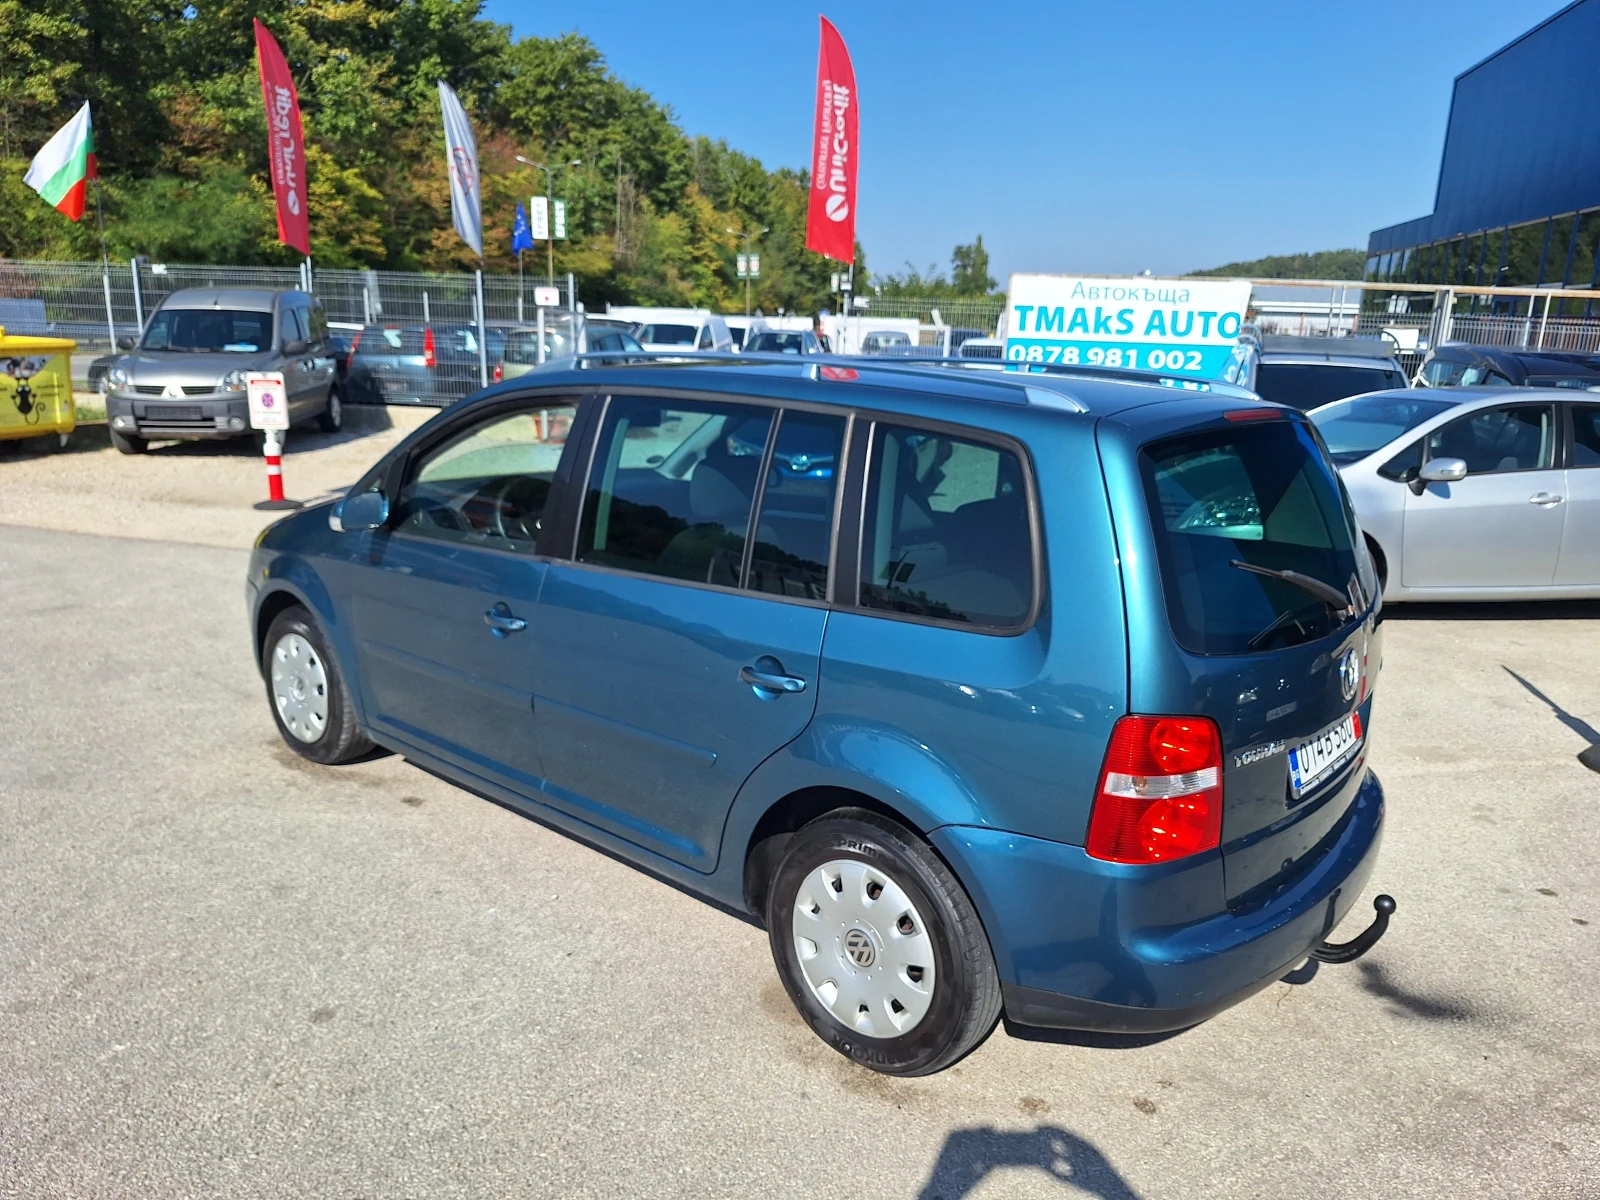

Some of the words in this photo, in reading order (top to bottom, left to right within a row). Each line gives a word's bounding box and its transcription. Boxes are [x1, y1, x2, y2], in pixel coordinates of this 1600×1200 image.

[1014, 305, 1134, 335] TMAkS
[1143, 310, 1241, 339] AUTO
[1008, 344, 1080, 366] 0878
[1086, 348, 1137, 370] 981
[1147, 350, 1203, 371] 002
